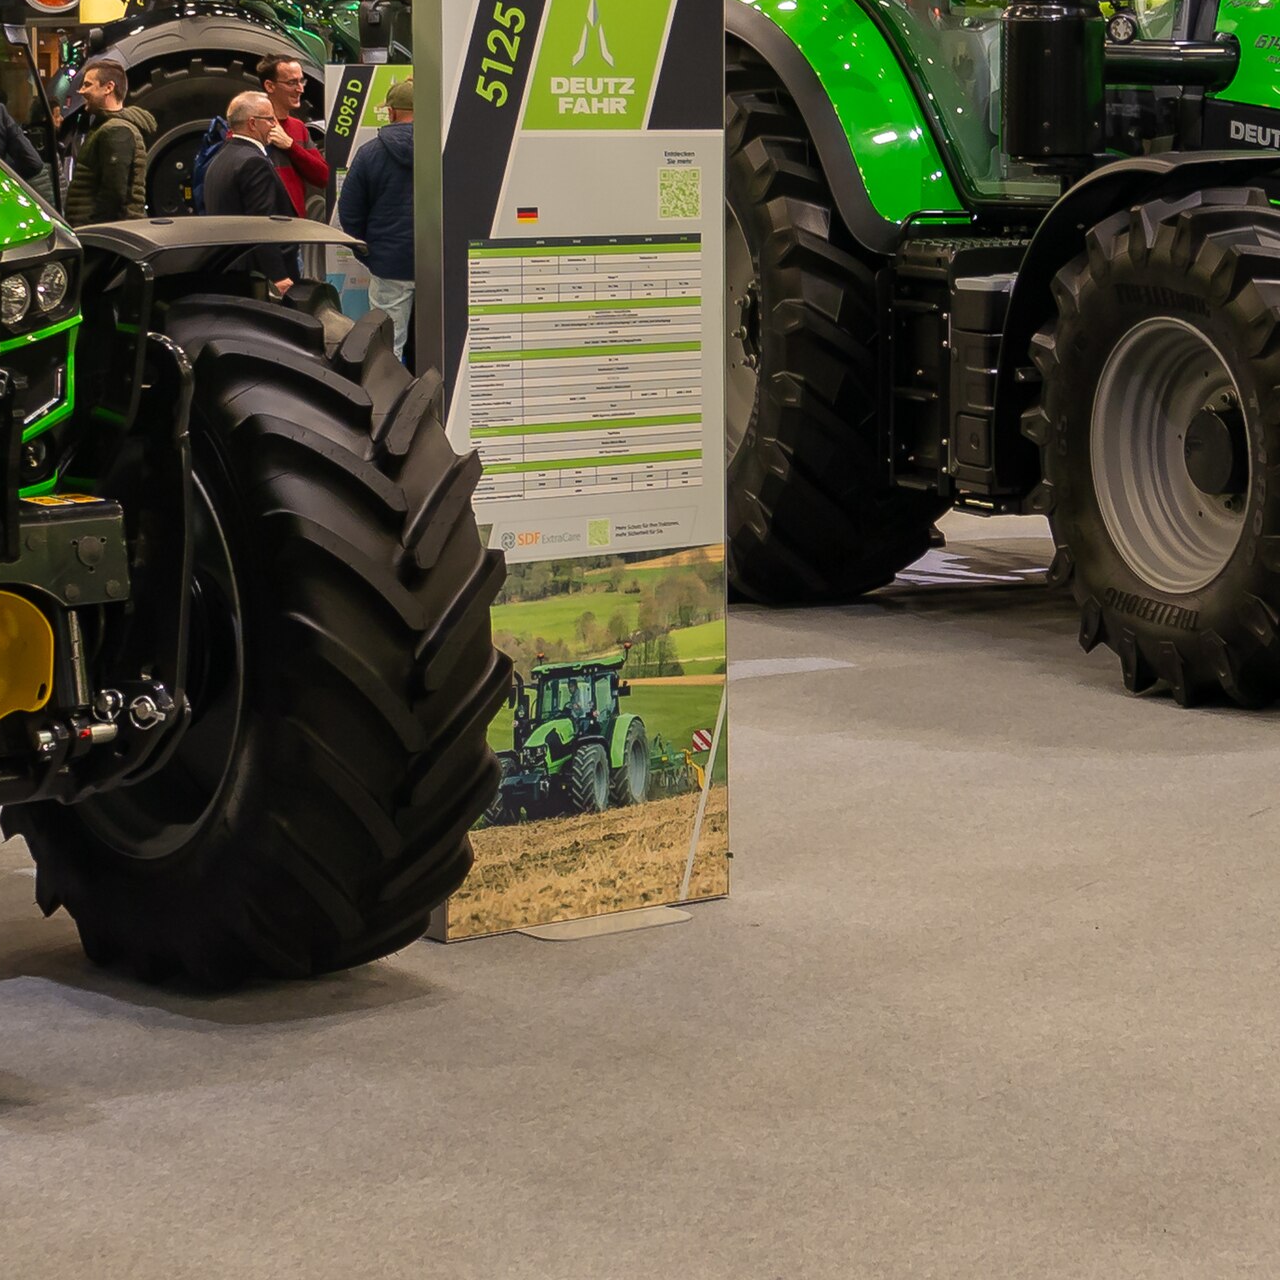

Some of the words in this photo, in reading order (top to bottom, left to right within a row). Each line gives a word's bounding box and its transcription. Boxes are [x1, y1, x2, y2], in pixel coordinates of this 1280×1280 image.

[476, 1, 526, 107] 5125
[550, 76, 635, 95] DEUTZ
[334, 95, 358, 137] 5095
[347, 79, 363, 93] D
[558, 97, 627, 114] FAHR
[517, 531, 540, 546] SDF
[542, 532, 581, 544] ExtraCare
